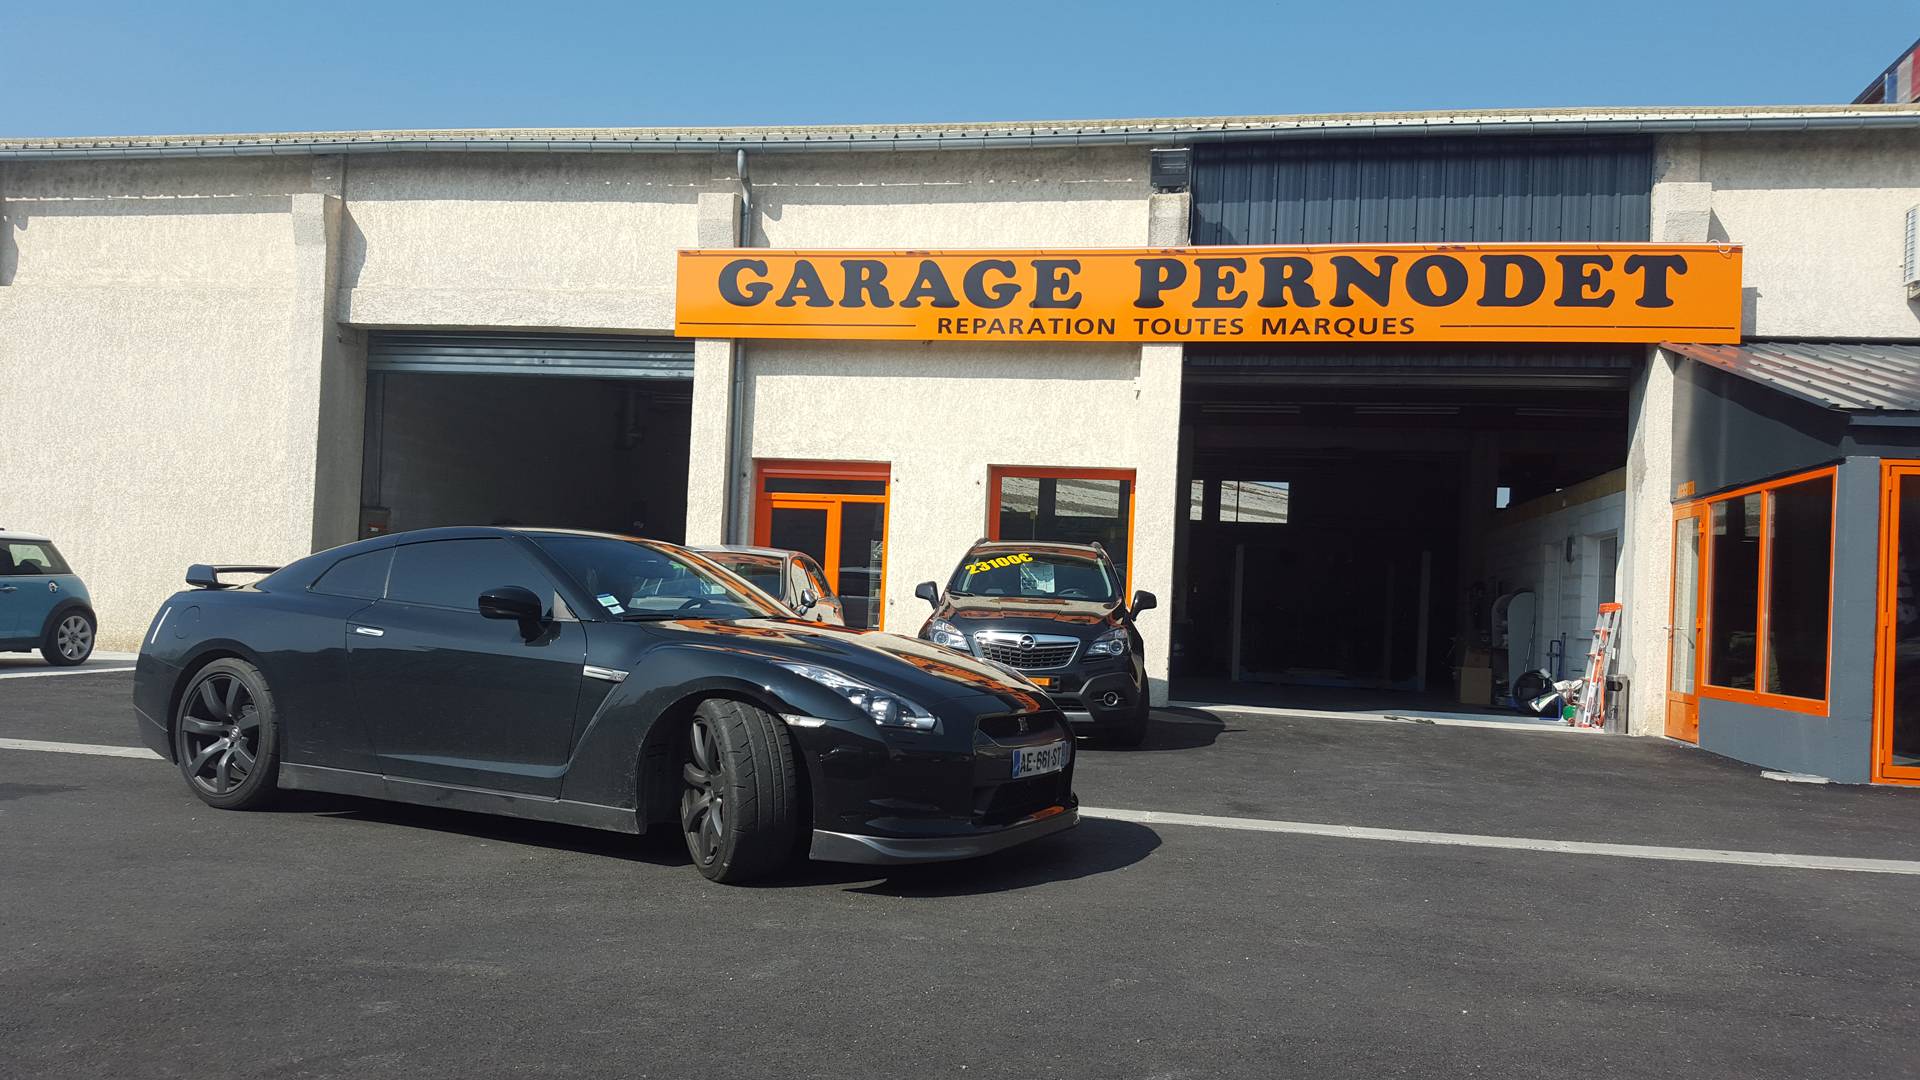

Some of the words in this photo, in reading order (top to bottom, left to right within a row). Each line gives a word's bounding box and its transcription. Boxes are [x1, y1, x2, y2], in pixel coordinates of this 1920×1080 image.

[718, 259, 1083, 310] GARAGE
[1133, 255, 1688, 309] PERNODET
[937, 317, 1115, 335] REPARATION
[1134, 318, 1244, 336] TOUTES
[1261, 317, 1415, 338] MARQUES
[964, 552, 1034, 575] 23100€
